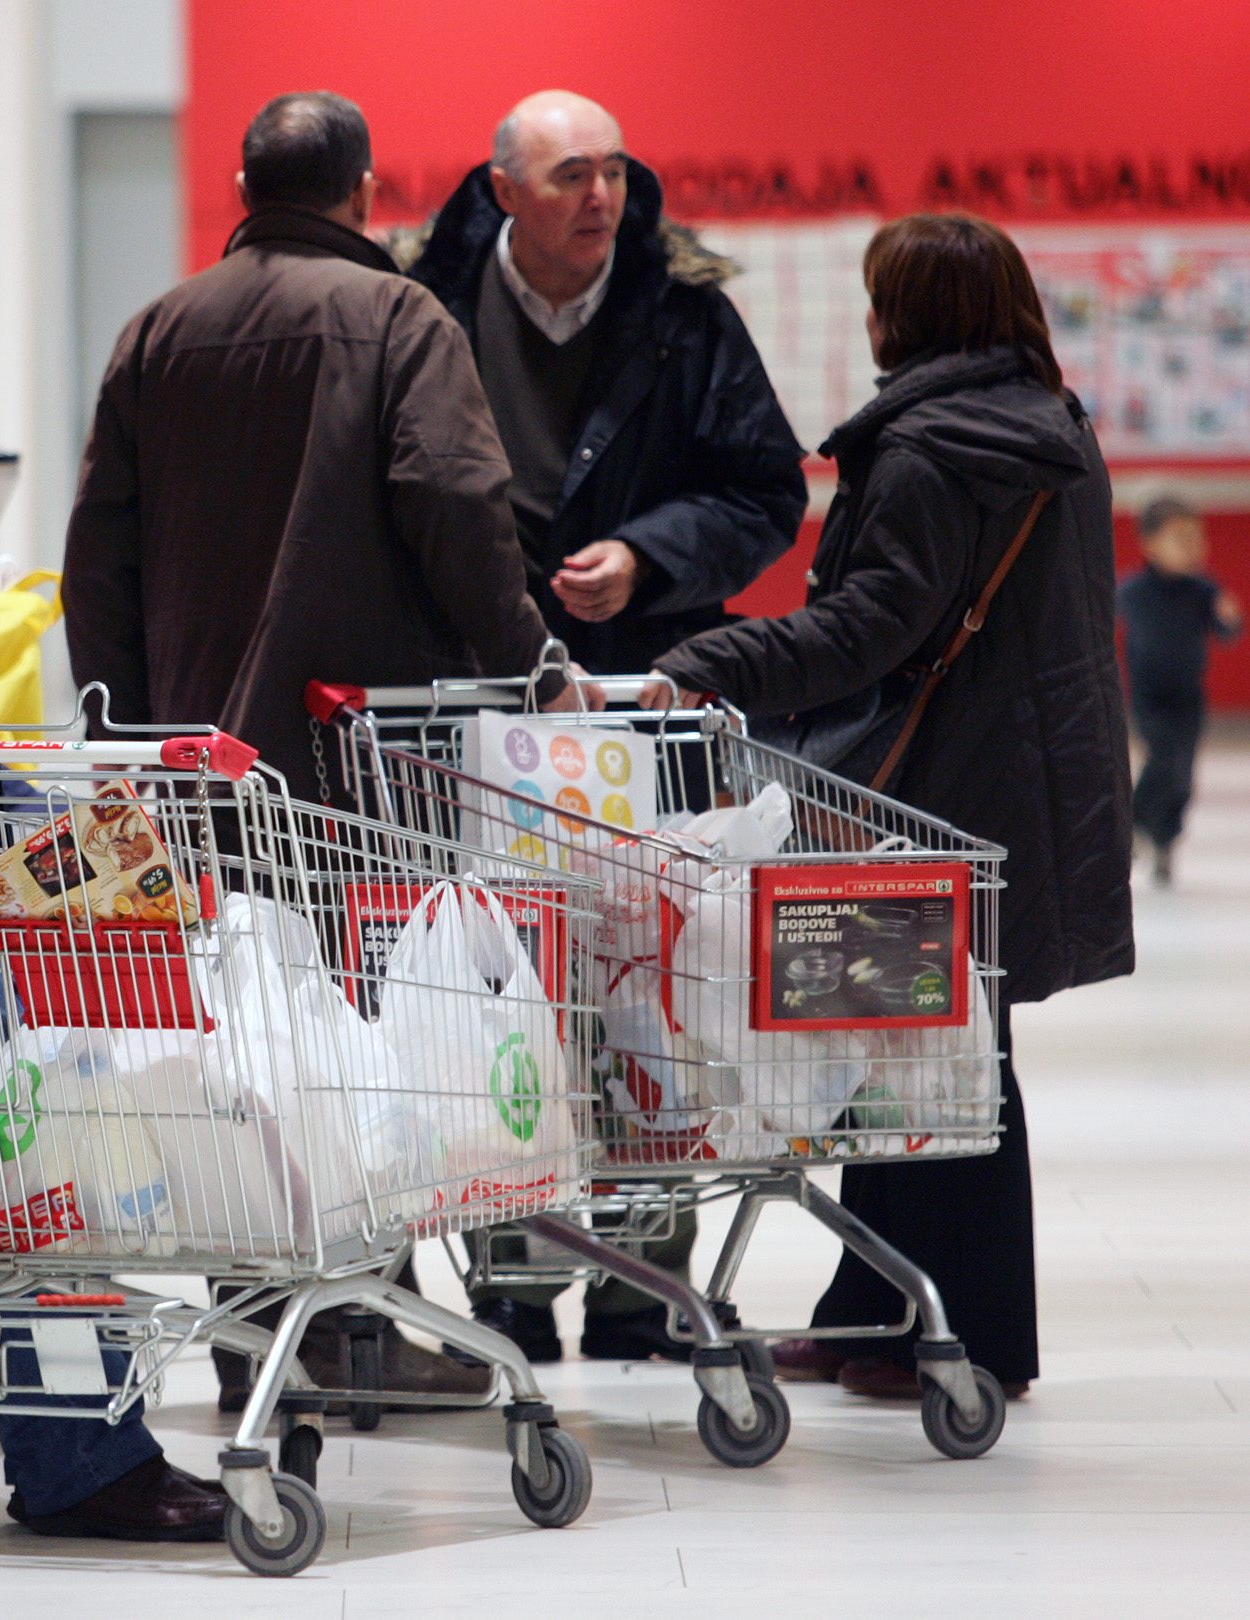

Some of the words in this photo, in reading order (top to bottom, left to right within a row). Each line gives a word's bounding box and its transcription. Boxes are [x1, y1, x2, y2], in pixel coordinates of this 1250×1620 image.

[774, 885, 829, 896] Ekskluzivno
[852, 881, 936, 892] INTERSPAR
[778, 904, 859, 917] SAKUPLJAJ
[778, 918, 837, 930] BODOVE
[916, 991, 945, 1006] 70%
